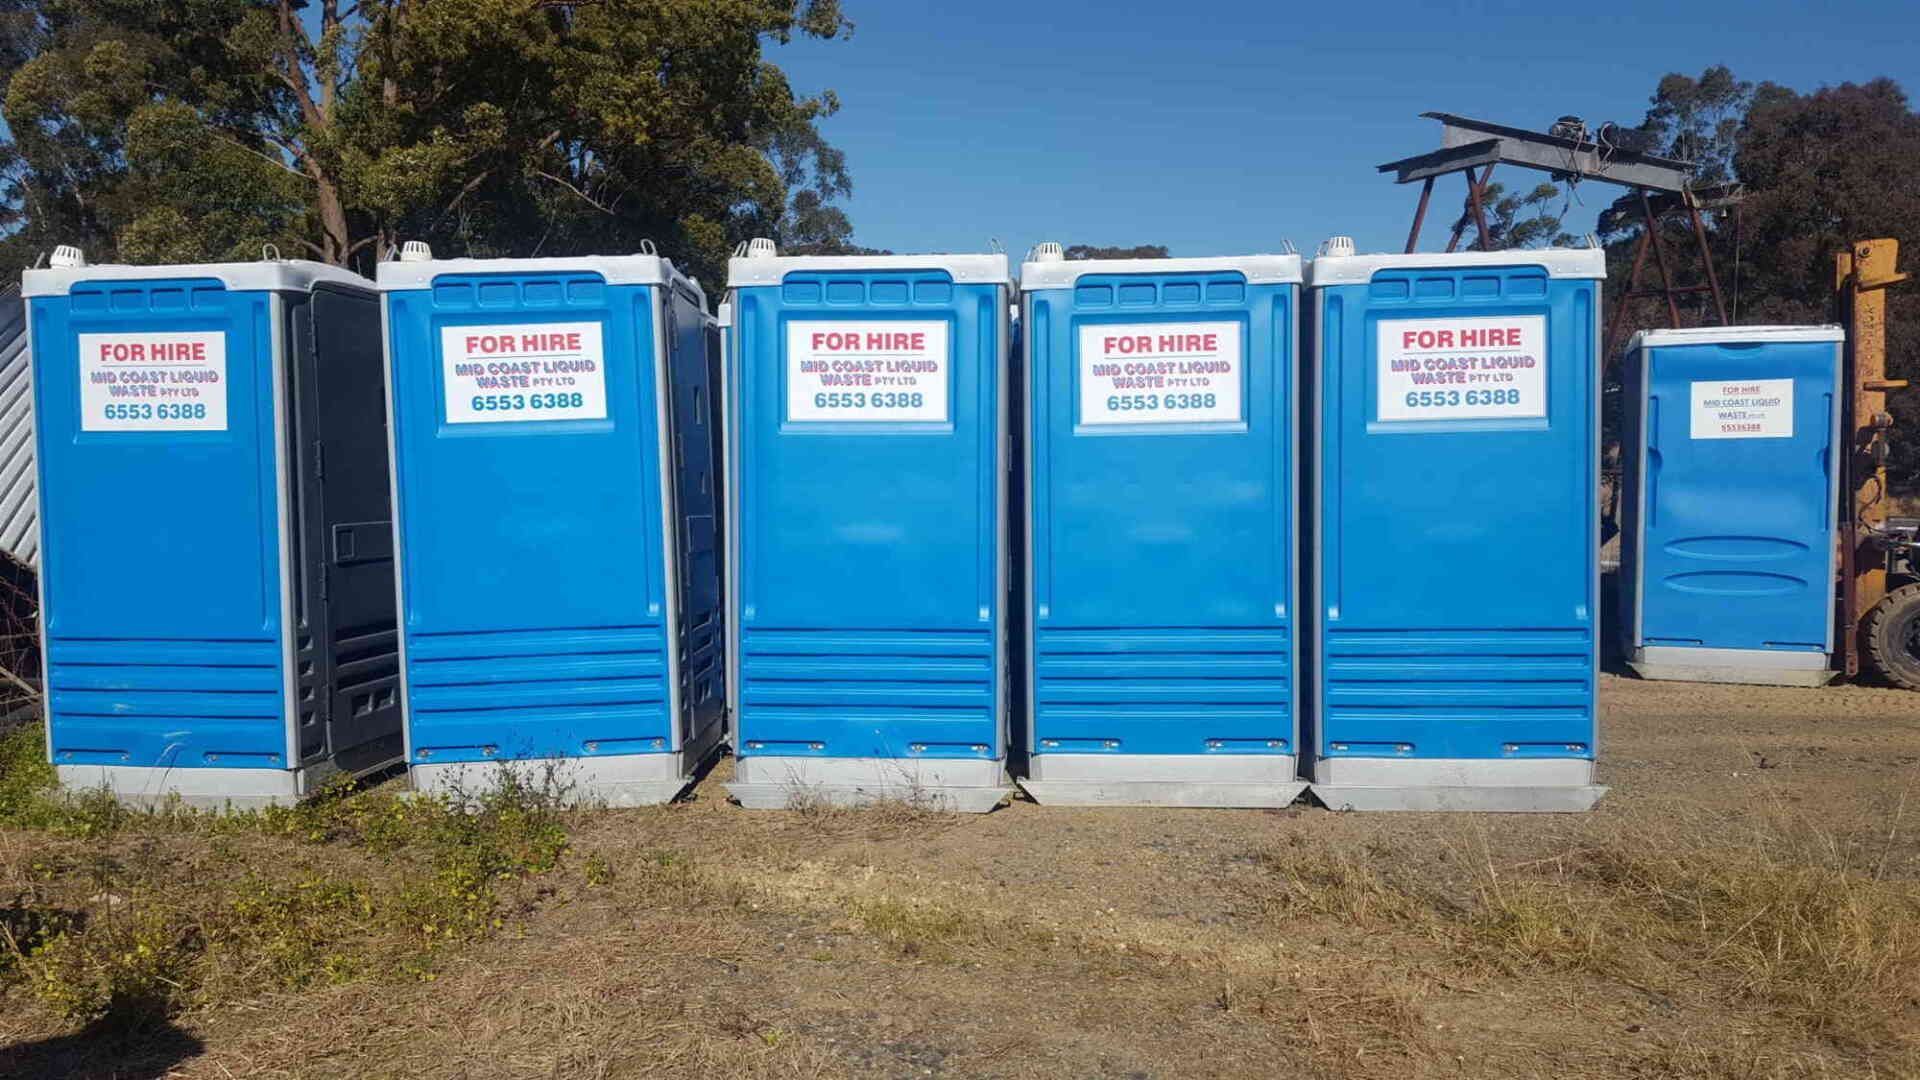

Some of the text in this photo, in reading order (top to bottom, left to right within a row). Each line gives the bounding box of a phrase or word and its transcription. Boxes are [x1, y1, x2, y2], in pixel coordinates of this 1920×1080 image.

[466, 333, 582, 353] FOR HIRE
[812, 332, 925, 350] FOR HIRE
[1104, 334, 1217, 354] FOR HIRE
[1403, 328, 1521, 349] FOR HIRE
[100, 343, 206, 361] FOR HIRE
[455, 359, 596, 376] MID COAST LIQUID
[800, 360, 938, 373] MID COAST LIQUID
[1092, 360, 1231, 376] MID COAST LIQUID
[1391, 355, 1536, 372] MID COAST LIQUID
[90, 370, 219, 384] MID COAST LIQUID
[476, 376, 576, 389] WASTE PTY LTD
[820, 374, 917, 386] WASTE PTY LTD
[1112, 376, 1210, 389] WASTE PTY LTD
[1411, 372, 1514, 385] WASTE PTY LTD
[110, 385, 200, 397] WASTE PTY LTD
[1406, 389, 1520, 407] 6553 6388
[1722, 386, 1761, 394] FOR HIRE
[472, 392, 583, 411] 6553 6388
[814, 392, 923, 408] 6553 6388
[1107, 393, 1216, 411] 6553 6388
[1704, 398, 1781, 407] MID COAST LIQUID
[104, 403, 206, 420] 6553 6388
